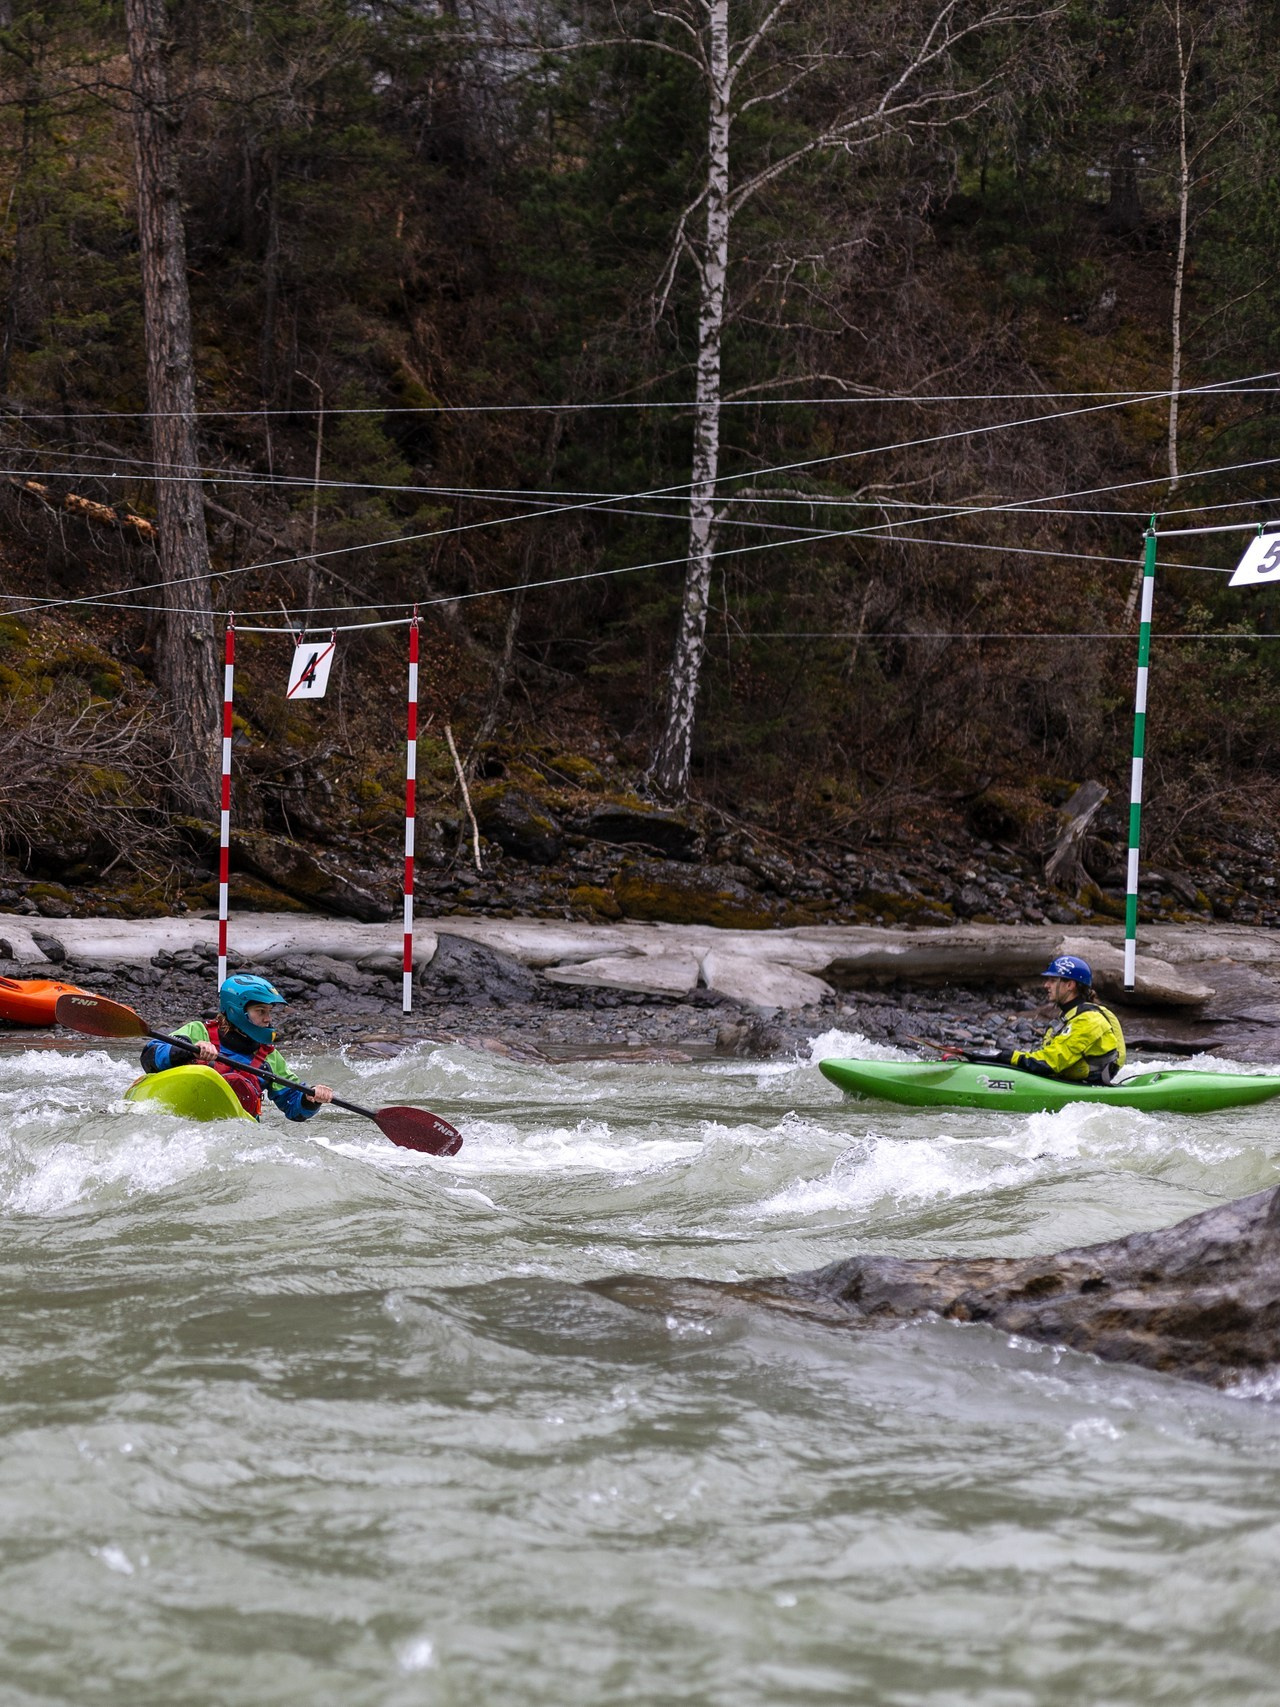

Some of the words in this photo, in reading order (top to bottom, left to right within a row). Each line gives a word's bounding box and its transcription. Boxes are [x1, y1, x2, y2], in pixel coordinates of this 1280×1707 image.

[1257, 540, 1280, 574] 5
[300, 652, 318, 688] 4
[71, 997, 98, 1006] TNP
[988, 1080, 1015, 1090] ZET
[433, 1121, 455, 1137] TNP
